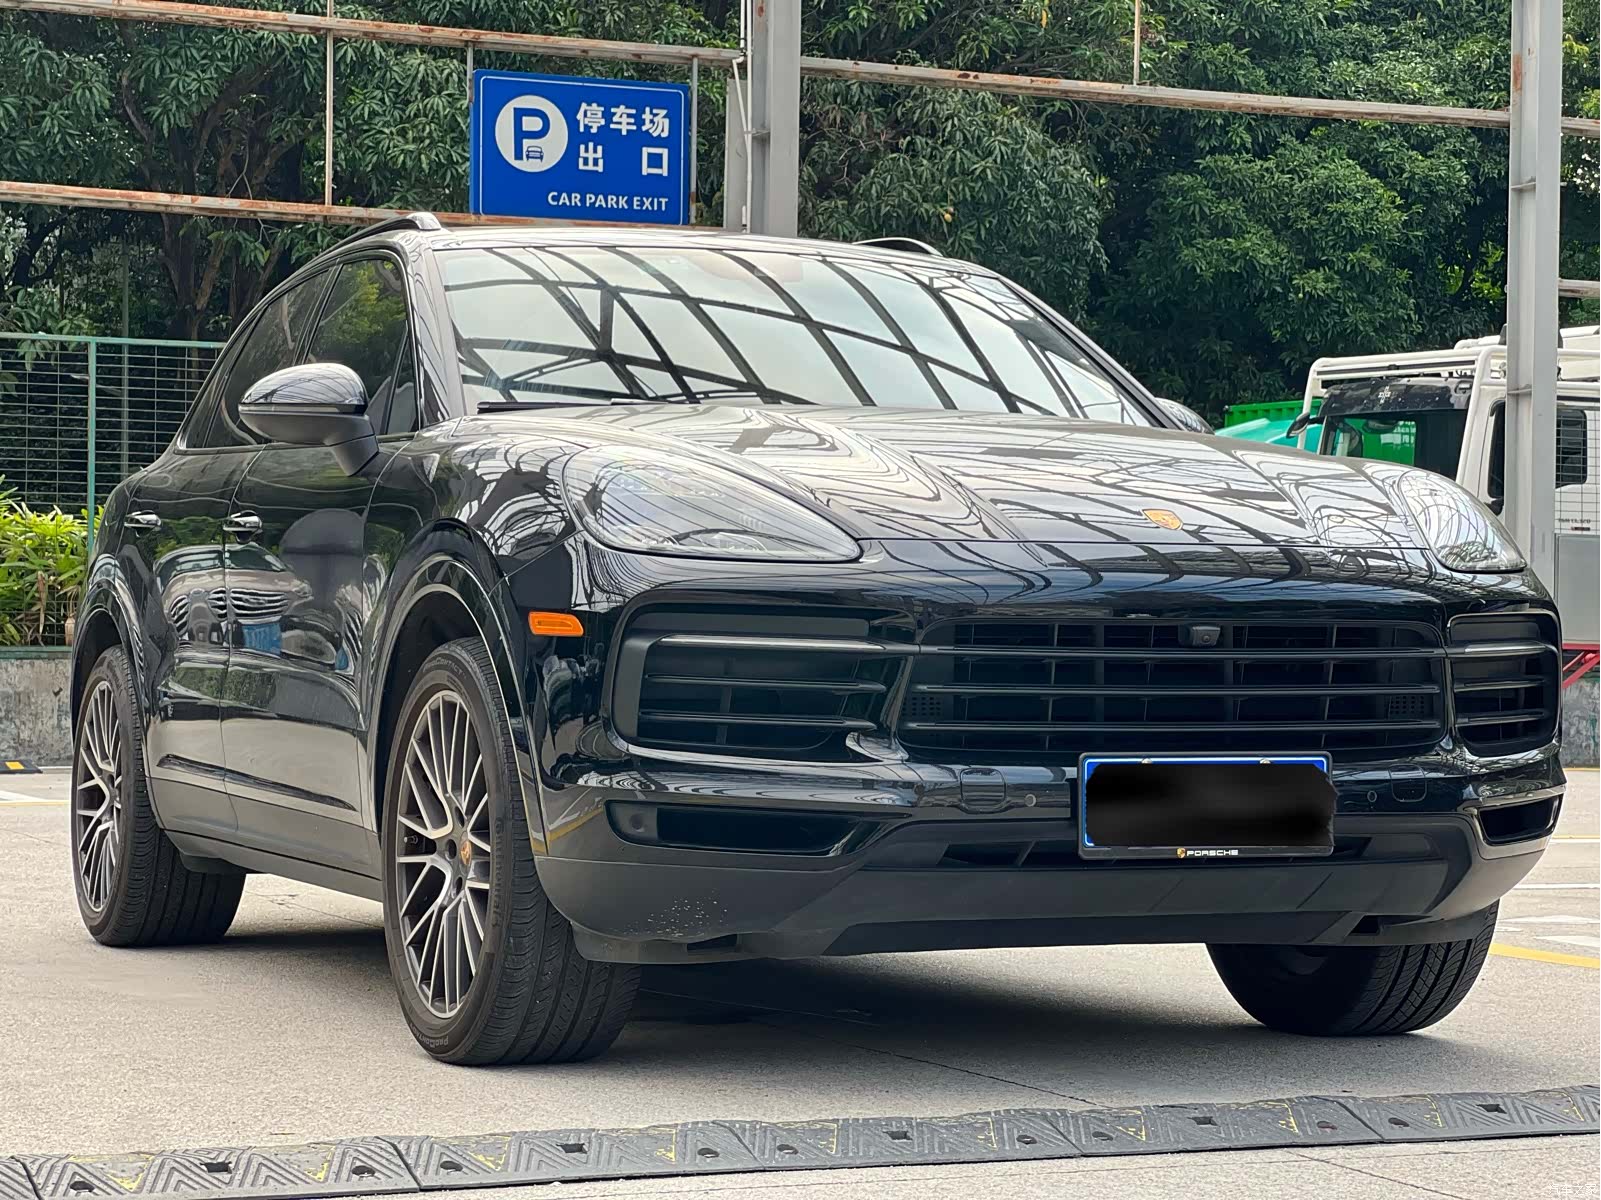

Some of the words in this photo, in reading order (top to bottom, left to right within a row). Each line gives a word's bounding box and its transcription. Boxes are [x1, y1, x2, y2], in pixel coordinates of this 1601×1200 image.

[576, 102, 669, 138] 停车场
[547, 191, 581, 207] CAR
[586, 193, 628, 209] PARK
[633, 196, 669, 211] EXIT
